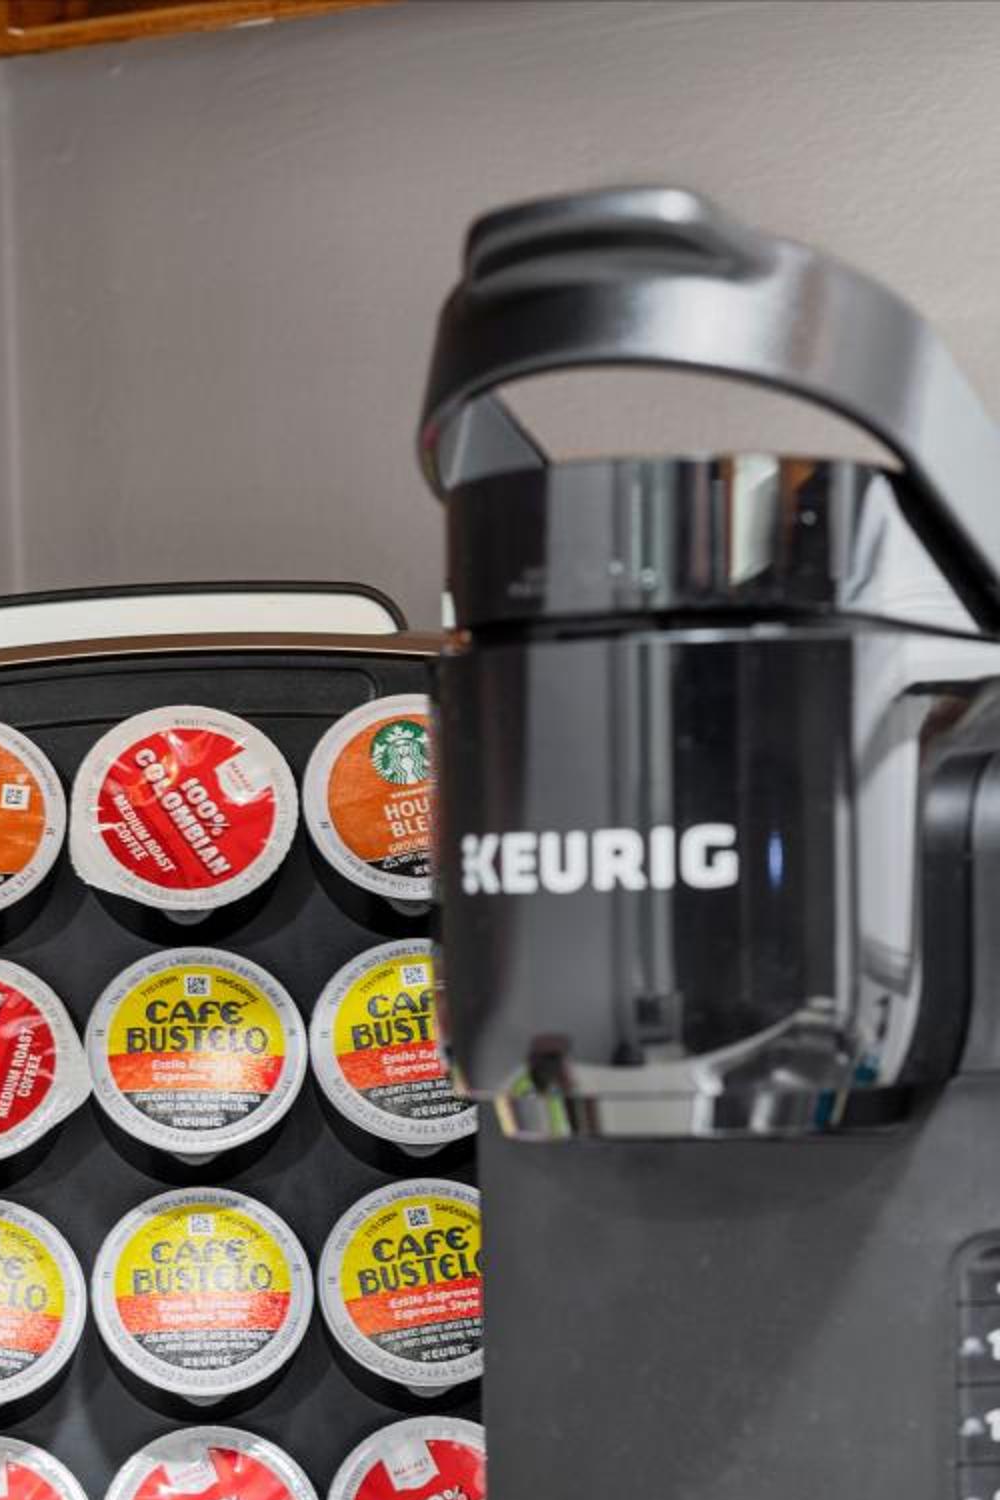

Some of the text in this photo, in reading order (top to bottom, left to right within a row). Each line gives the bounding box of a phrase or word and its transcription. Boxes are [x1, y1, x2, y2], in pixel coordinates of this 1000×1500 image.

[135, 748, 233, 876] COLOMBIAN
[180, 777, 231, 837] 100%
[384, 796, 431, 820] HOU
[391, 815, 432, 838] BLE
[113, 793, 178, 873] MEDIUM ROAST
[114, 823, 150, 862] COFFEE
[461, 823, 739, 896] KEURIG
[126, 1026, 268, 1055] BUSTELO
[351, 1015, 431, 1050] BUST
[16, 1053, 43, 1098] COFFEE
[133, 1263, 273, 1294] BUSTELO
